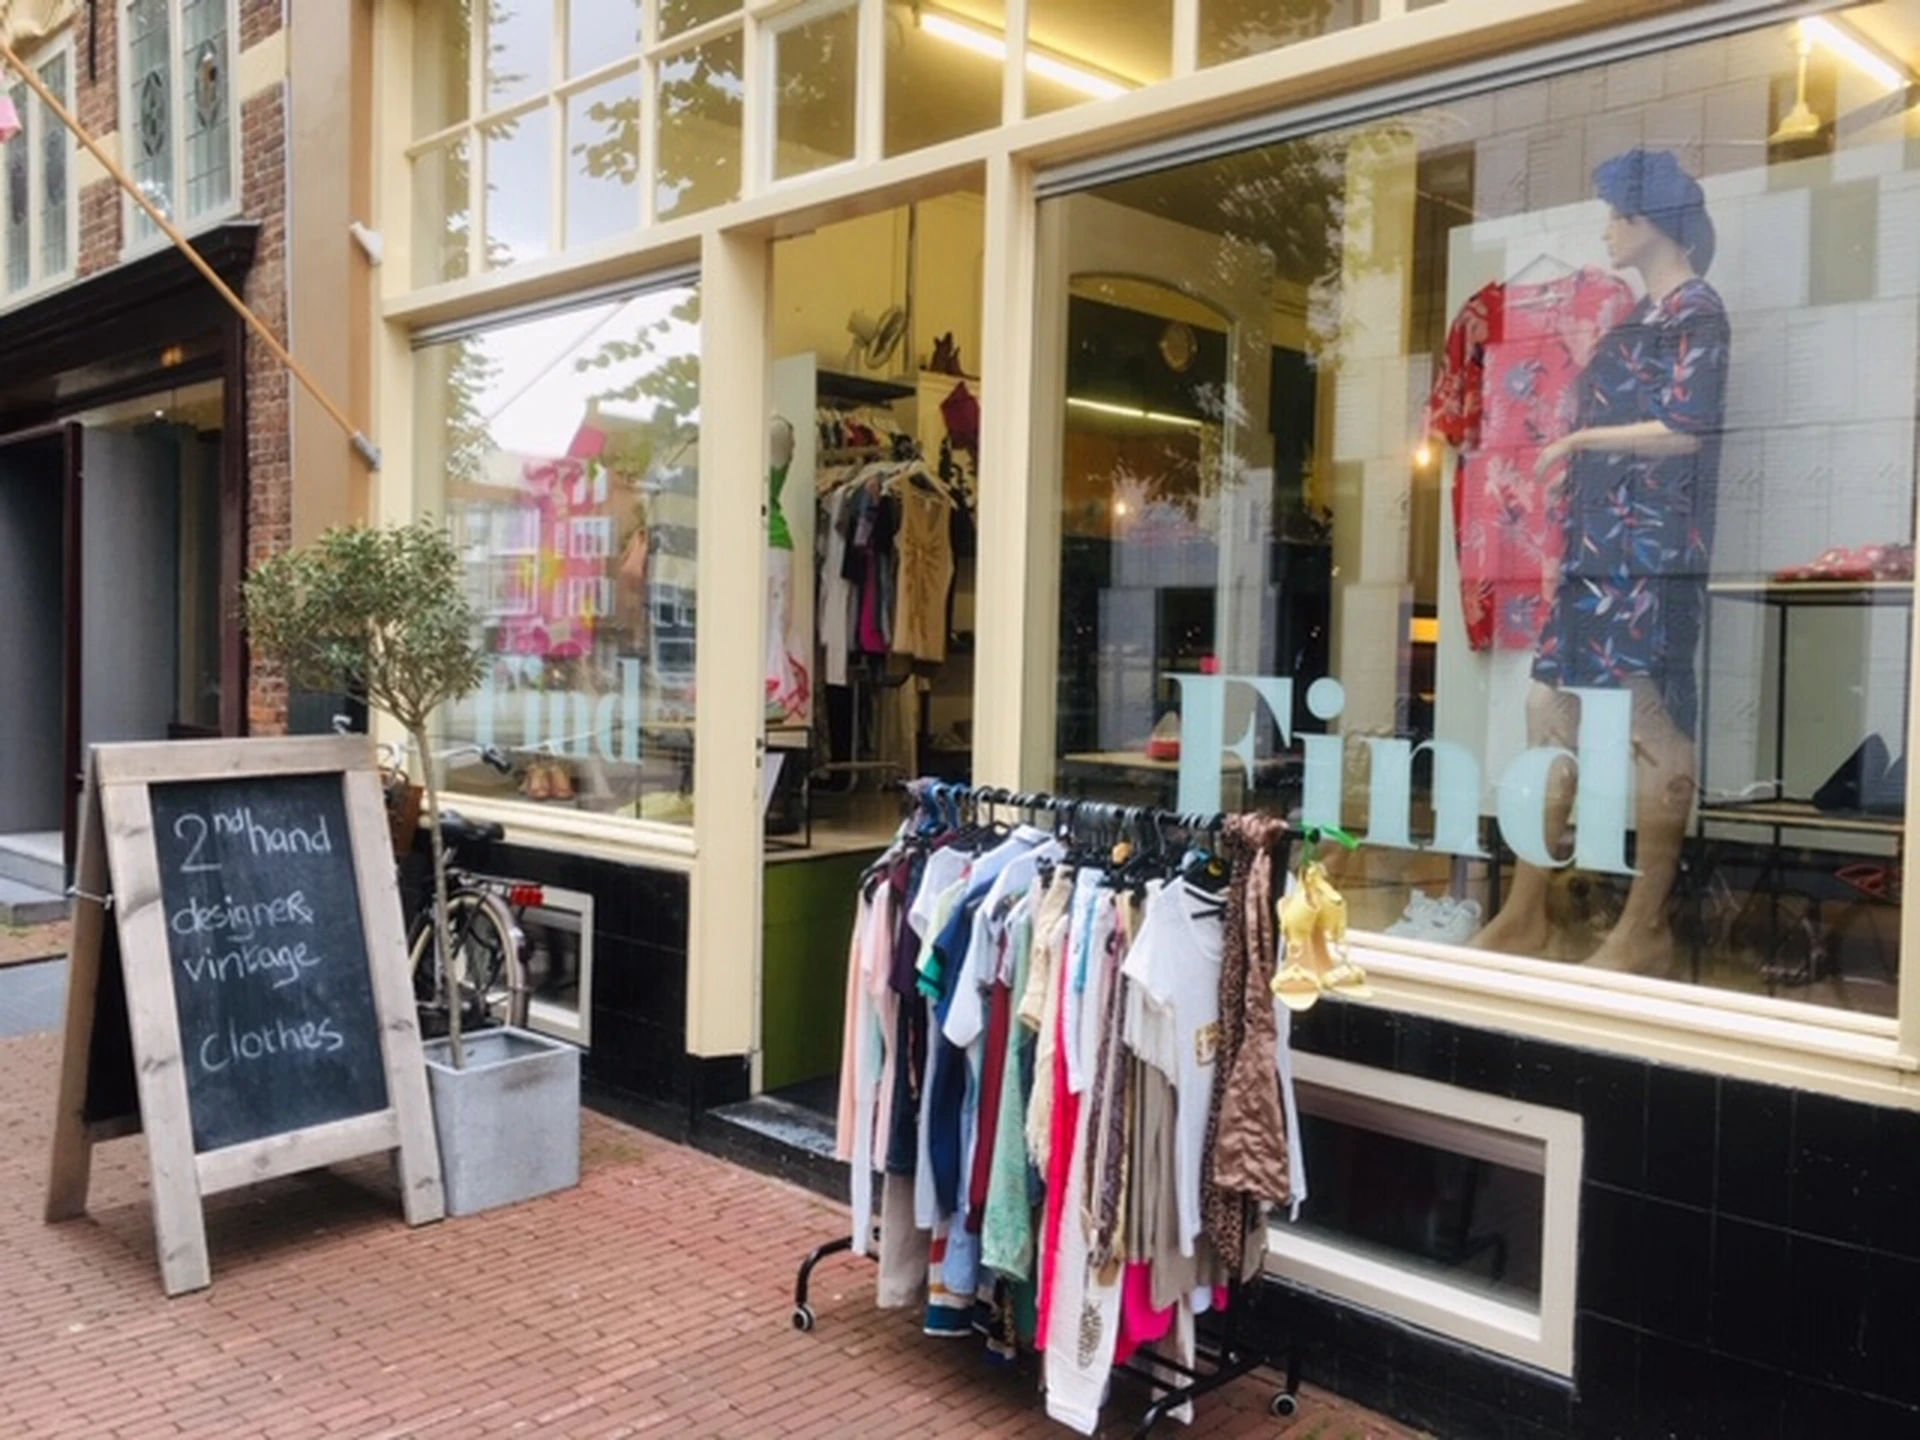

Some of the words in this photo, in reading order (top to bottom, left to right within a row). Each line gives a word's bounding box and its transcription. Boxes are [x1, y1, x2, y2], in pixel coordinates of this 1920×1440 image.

[1163, 673, 1643, 875] Find
[174, 806, 244, 873] 2nd
[245, 806, 332, 856] hand
[182, 941, 321, 989] vintage
